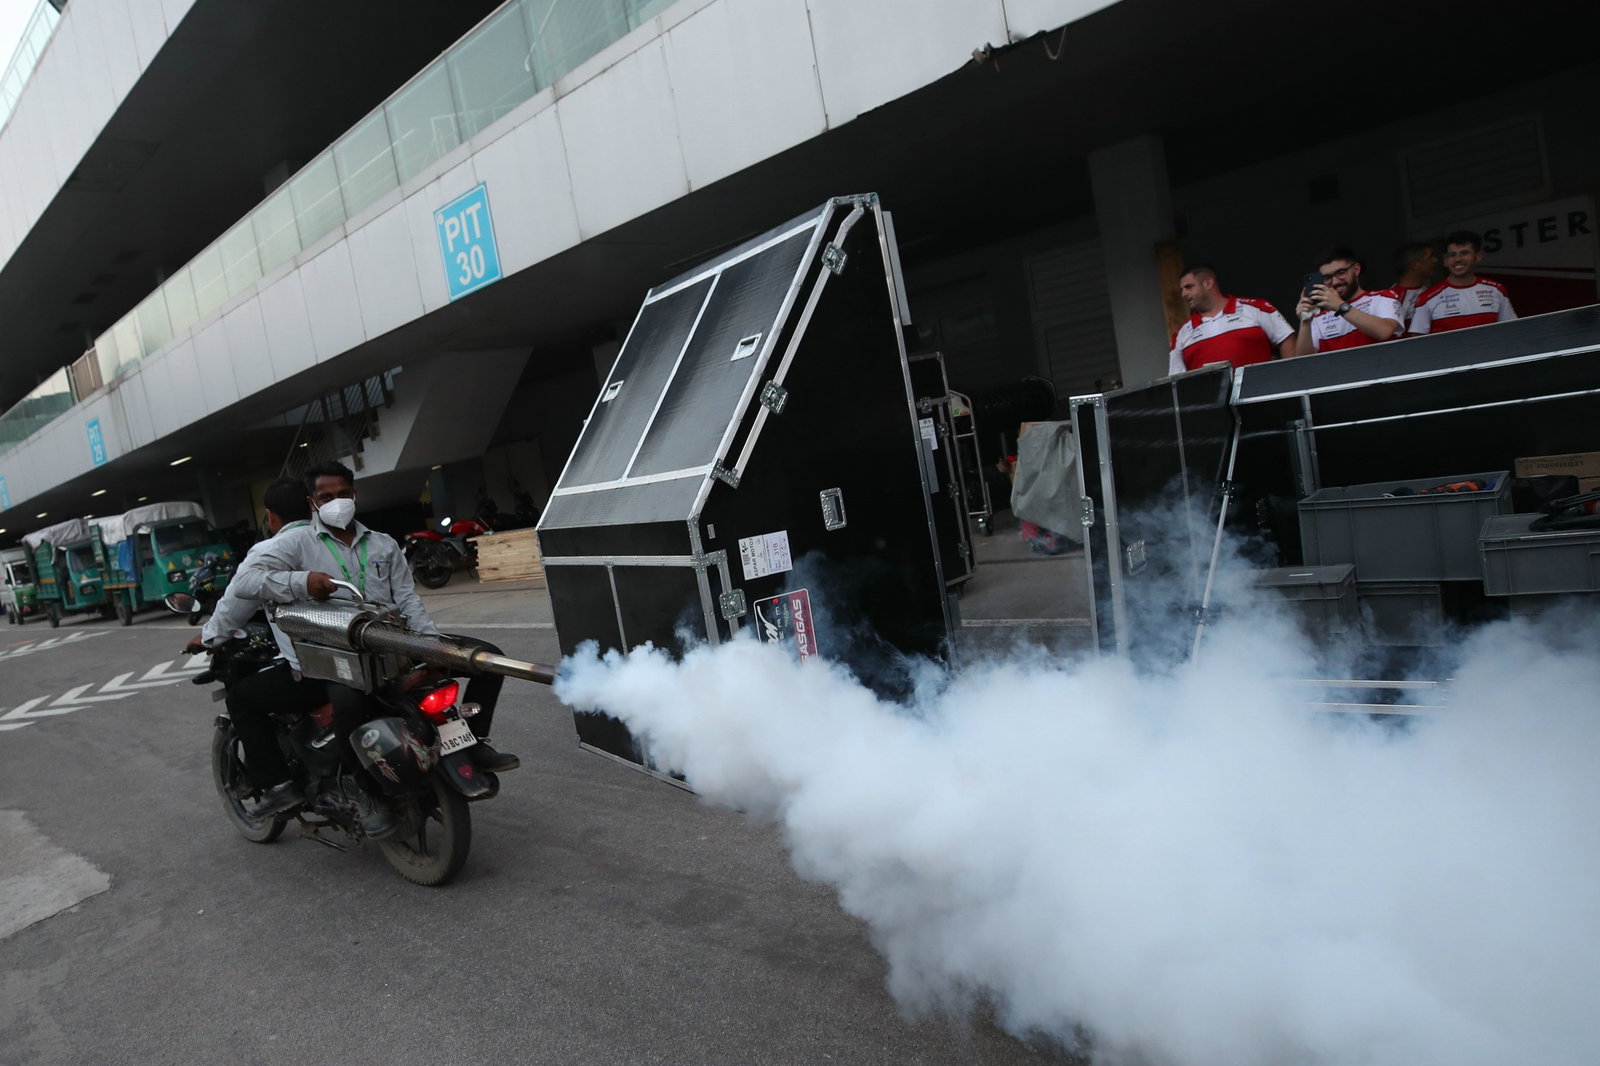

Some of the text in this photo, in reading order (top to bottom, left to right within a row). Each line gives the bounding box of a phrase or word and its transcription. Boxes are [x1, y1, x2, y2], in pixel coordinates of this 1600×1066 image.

[444, 201, 482, 253] PIT
[456, 244, 485, 285] 30
[448, 738, 460, 748] BC
